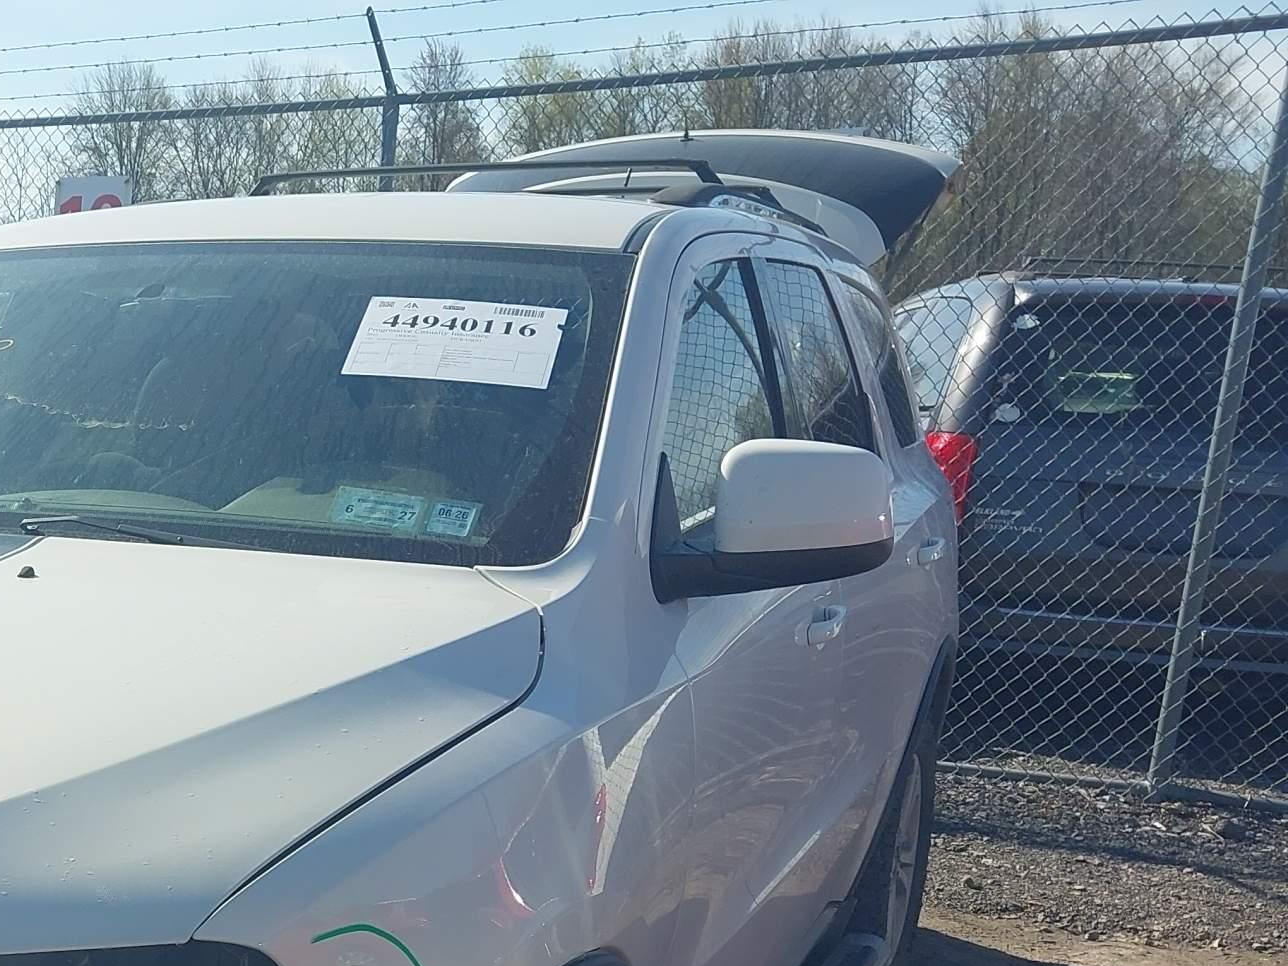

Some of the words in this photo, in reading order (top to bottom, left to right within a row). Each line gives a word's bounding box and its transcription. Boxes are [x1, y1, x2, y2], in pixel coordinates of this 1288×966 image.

[382, 313, 539, 338] 44940116
[345, 504, 354, 513] 6
[398, 510, 416, 520] 27
